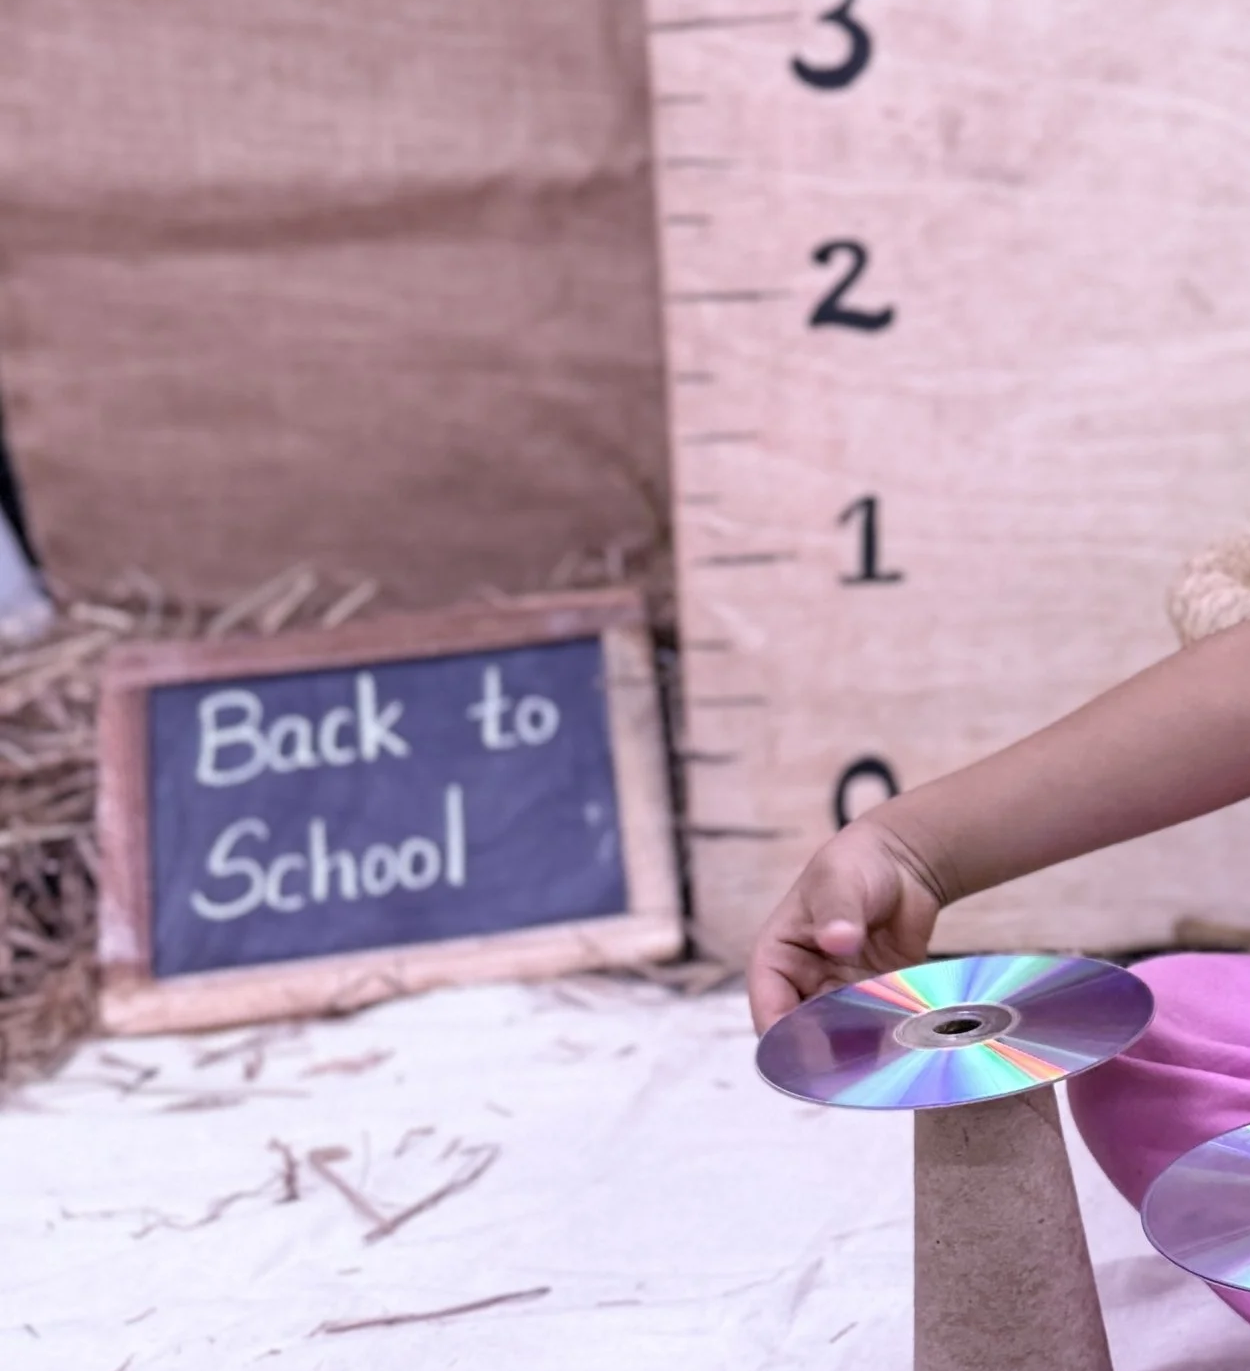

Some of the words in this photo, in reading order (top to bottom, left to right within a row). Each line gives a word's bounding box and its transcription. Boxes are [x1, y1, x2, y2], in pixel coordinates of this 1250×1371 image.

[808, 239, 897, 332] 2
[837, 495, 905, 585] 1
[195, 671, 410, 786] Back
[467, 664, 561, 750] to
[190, 783, 466, 921] School
